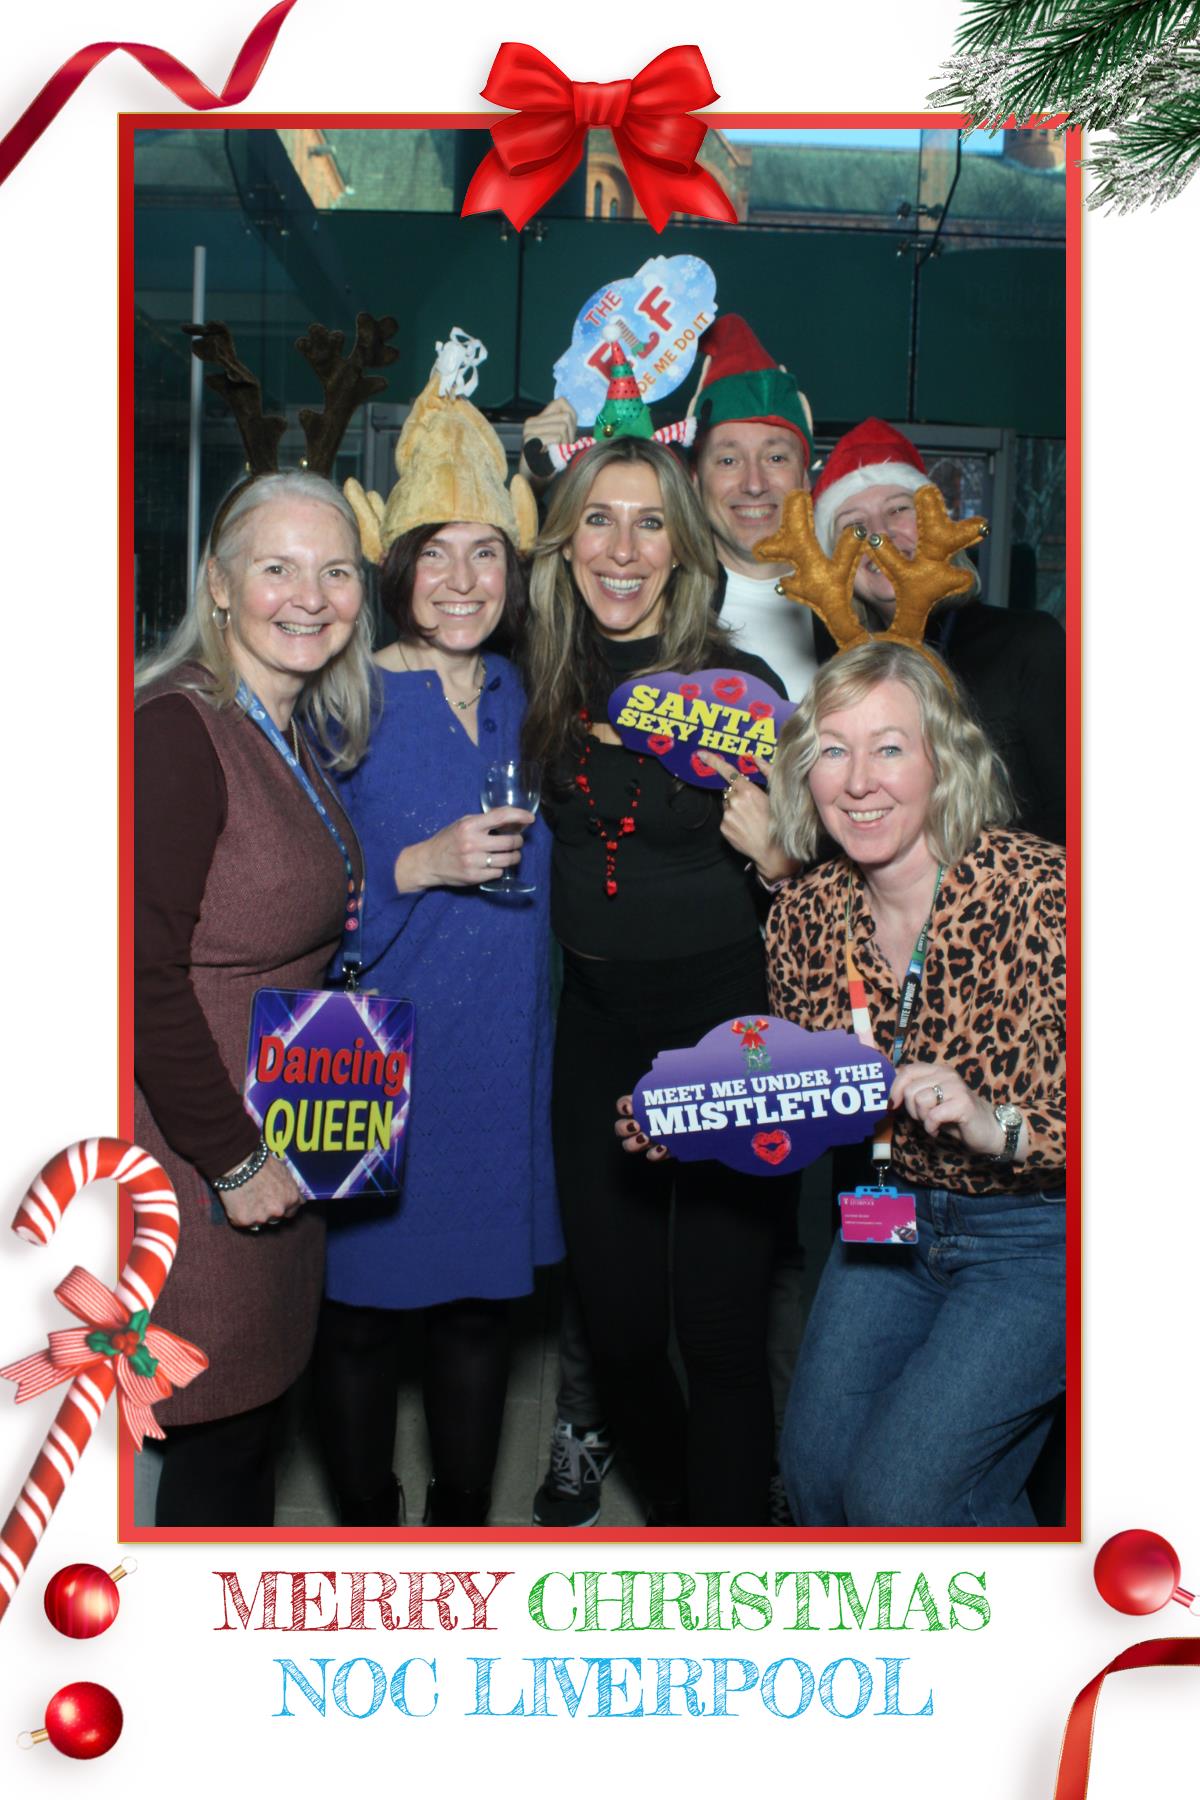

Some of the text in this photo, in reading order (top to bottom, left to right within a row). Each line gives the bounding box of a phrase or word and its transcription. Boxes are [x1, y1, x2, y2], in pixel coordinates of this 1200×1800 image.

[584, 290, 622, 325] THE
[639, 312, 709, 395] DE ME DO IT
[616, 708, 778, 763] SEXY HELP
[626, 684, 777, 745] SANTA
[256, 1035, 408, 1096] Dancing
[642, 1062, 884, 1106] MEET ME UNDER THE
[264, 1098, 394, 1160] QUEEN
[646, 1081, 888, 1137] MISTLETOE
